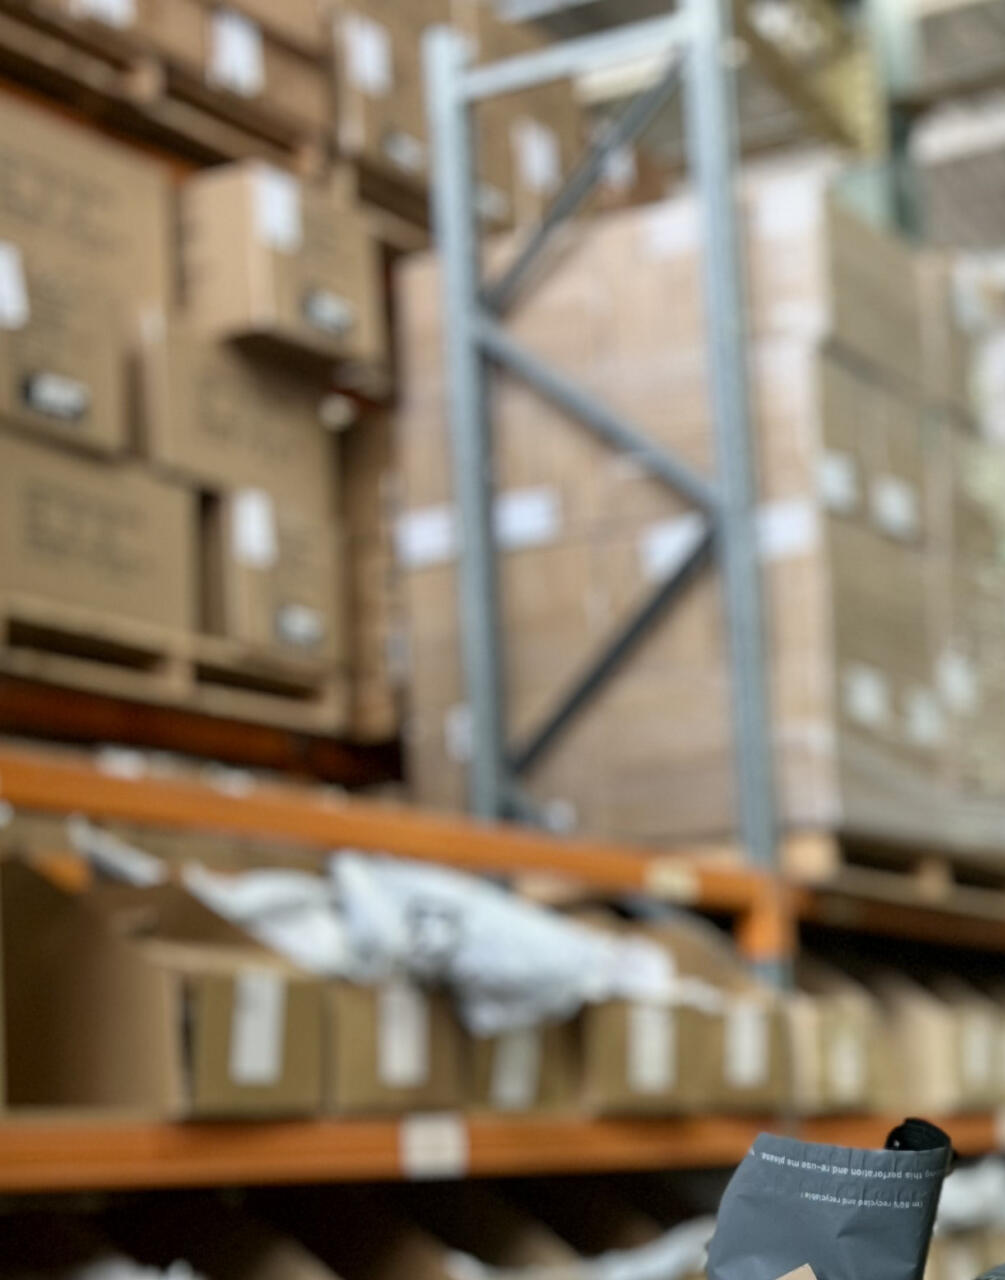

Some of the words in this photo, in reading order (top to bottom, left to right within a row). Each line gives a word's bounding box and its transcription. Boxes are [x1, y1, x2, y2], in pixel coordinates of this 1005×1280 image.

[786, 1158, 800, 1167] me
[801, 1161, 831, 1173] re-use
[831, 1165, 849, 1175] and
[850, 1168, 903, 1179] perforation
[905, 1171, 923, 1179] this
[841, 1195, 857, 1206] and
[857, 1198, 892, 1208] recycled
